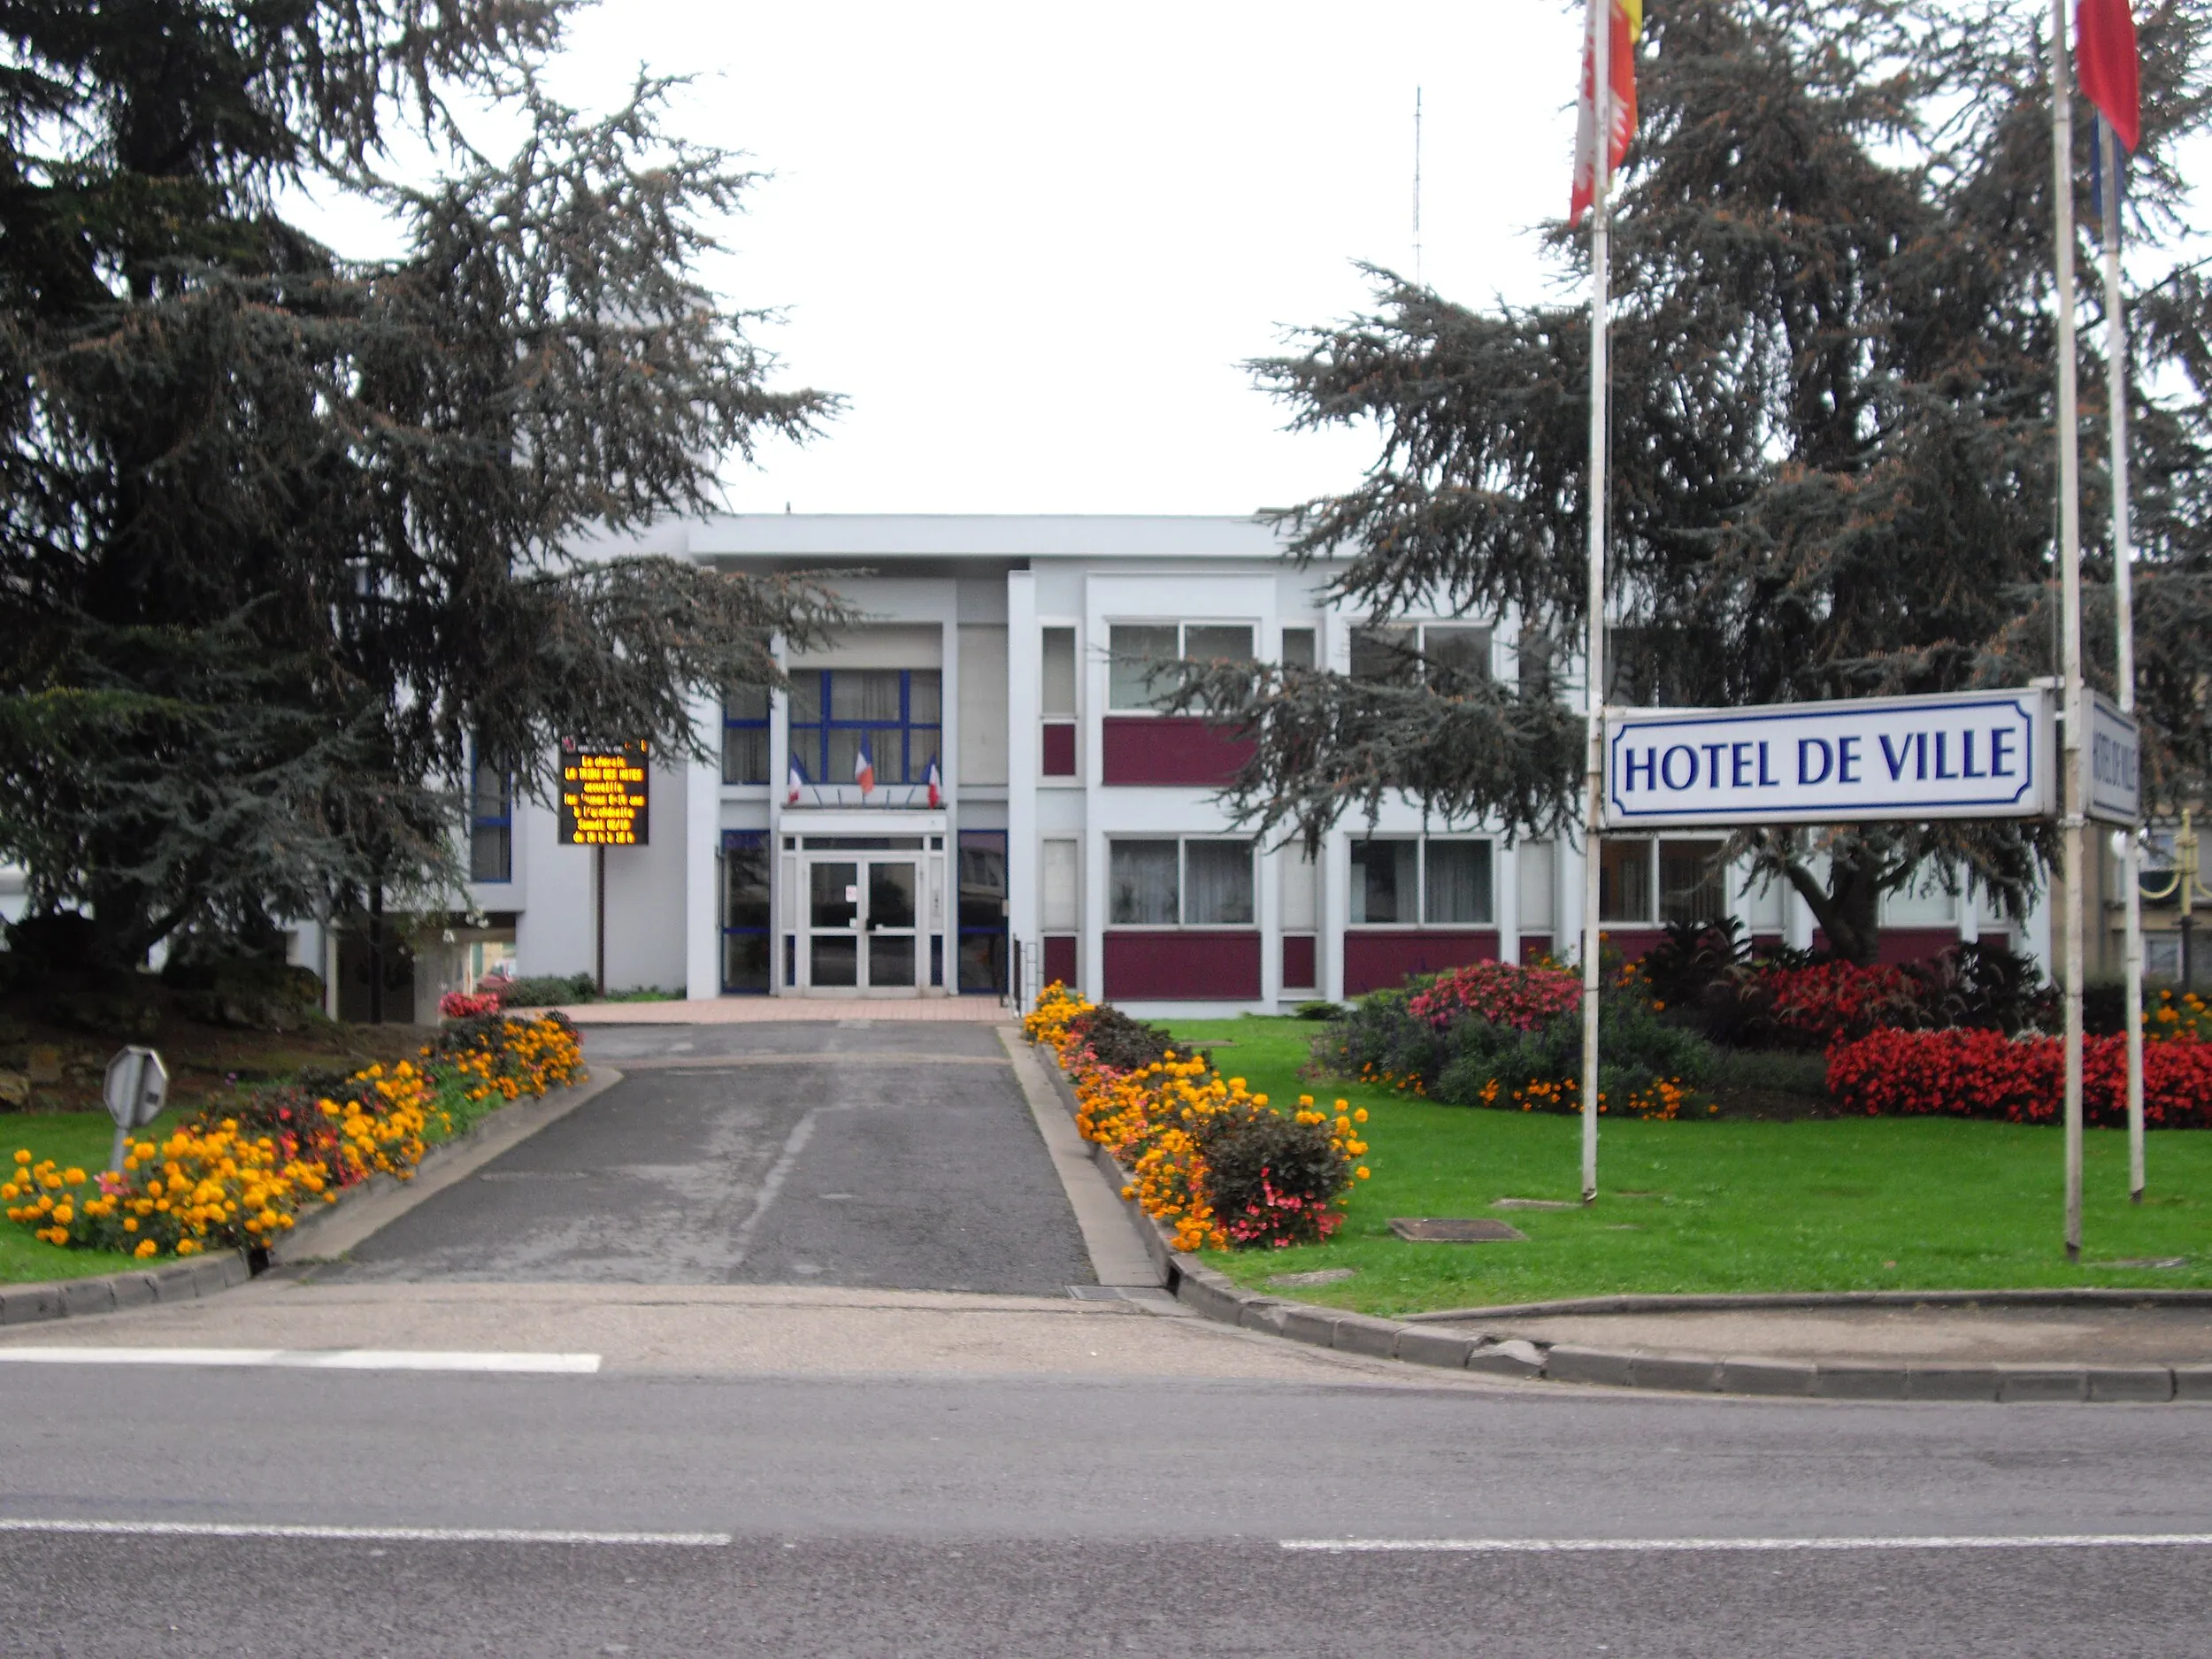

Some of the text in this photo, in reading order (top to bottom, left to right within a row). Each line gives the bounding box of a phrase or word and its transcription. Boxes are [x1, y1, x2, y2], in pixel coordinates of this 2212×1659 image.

[565, 767, 578, 780] LA
[1625, 726, 2016, 792] HOTEL DE VILLE
